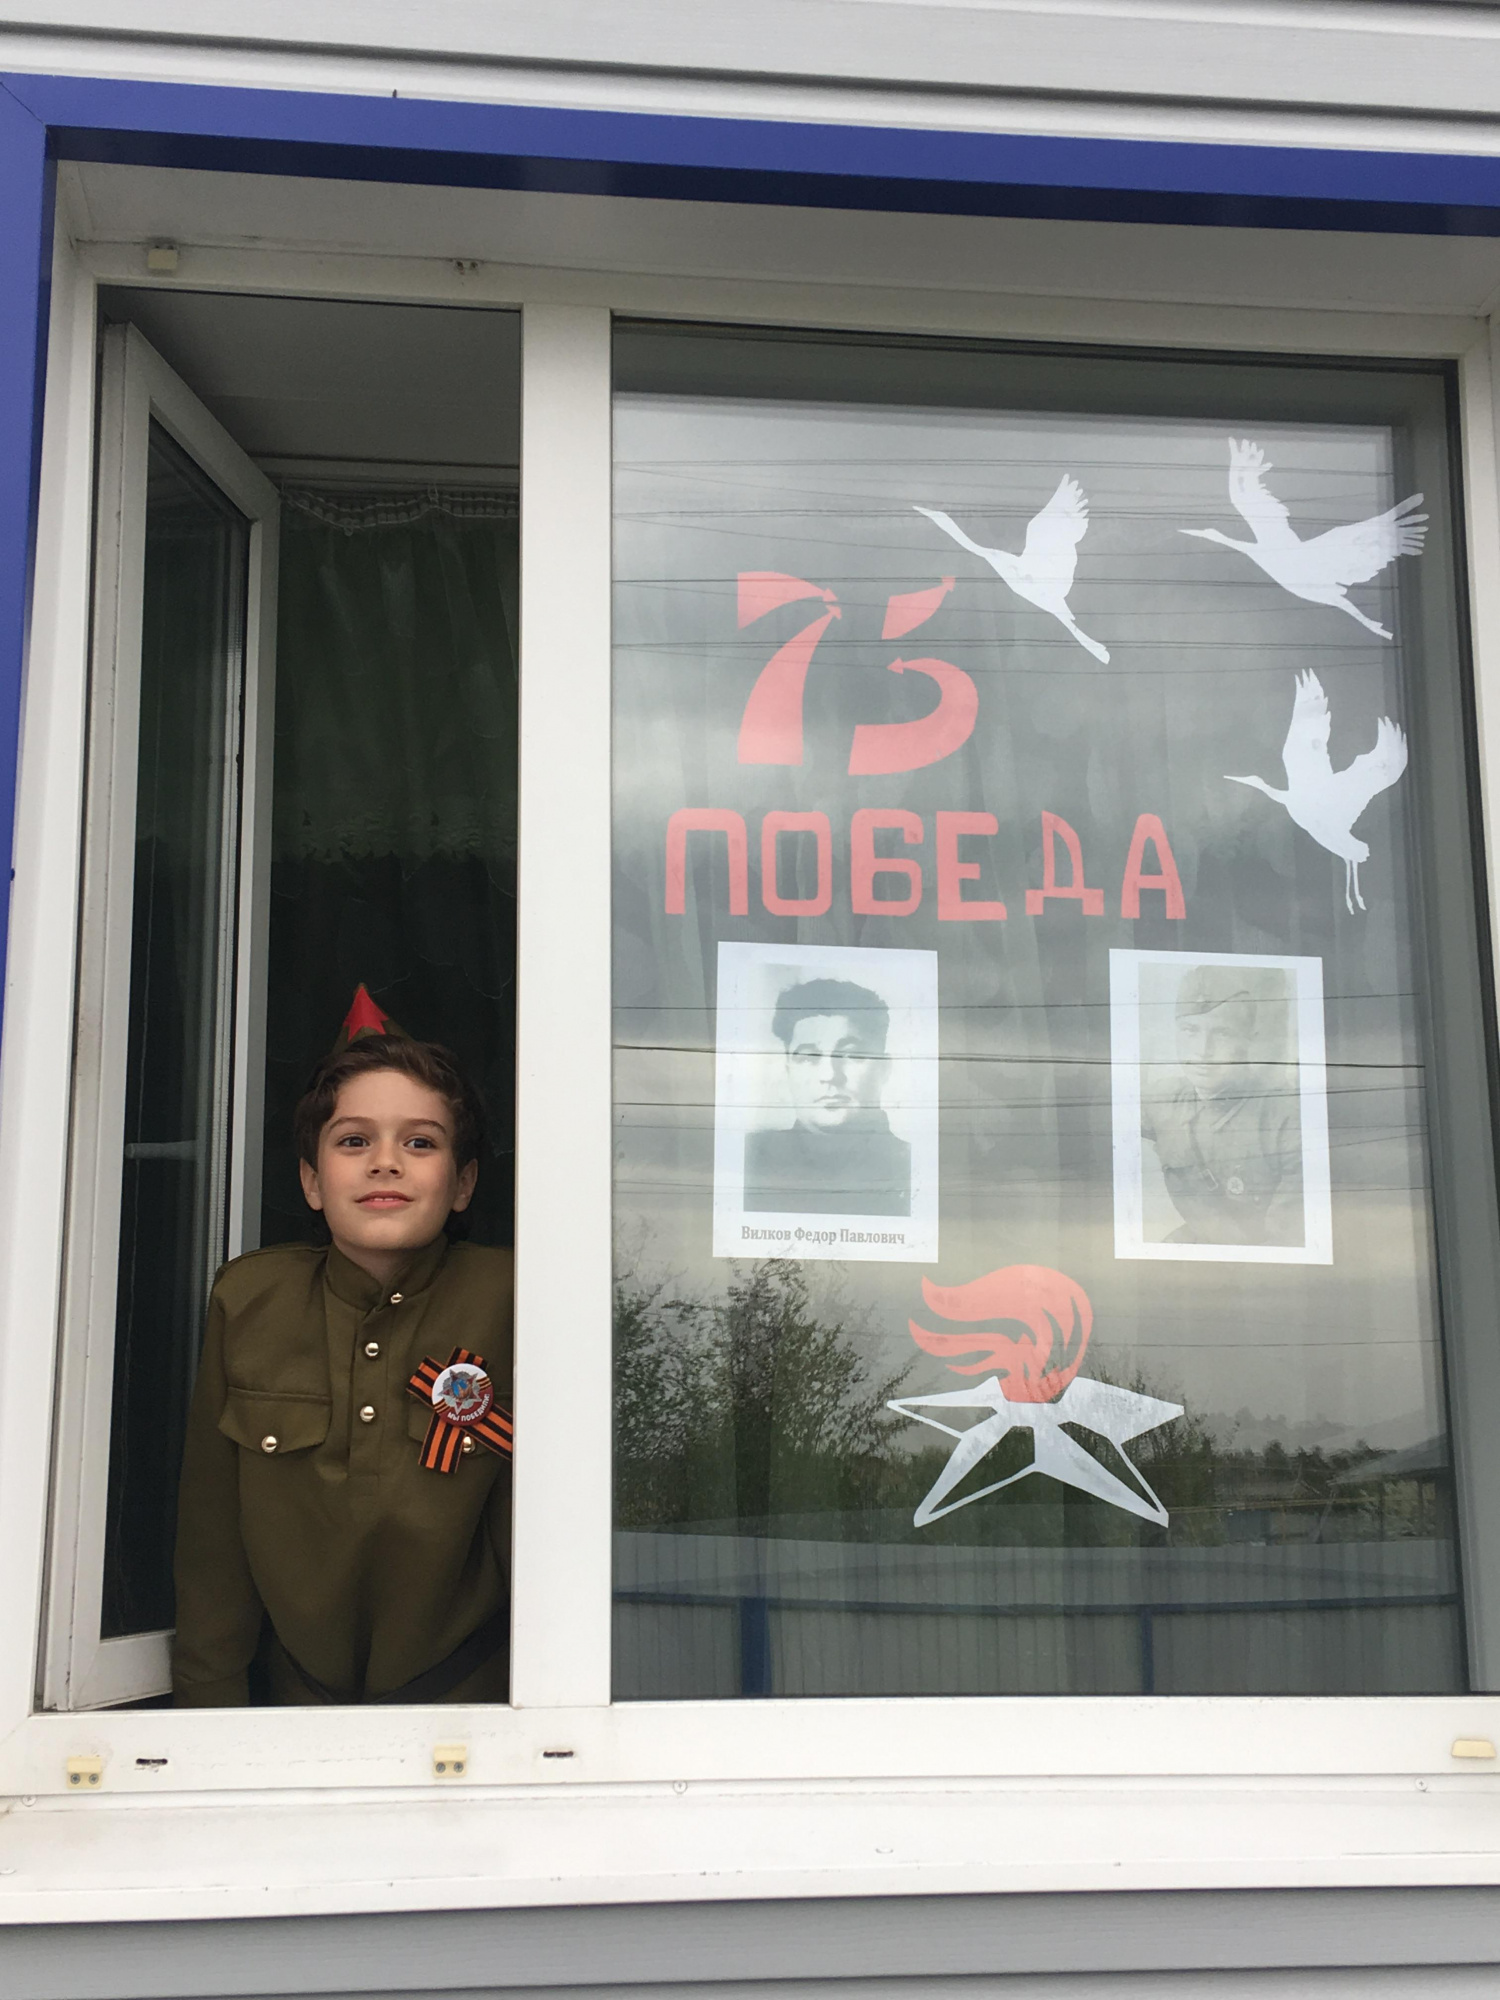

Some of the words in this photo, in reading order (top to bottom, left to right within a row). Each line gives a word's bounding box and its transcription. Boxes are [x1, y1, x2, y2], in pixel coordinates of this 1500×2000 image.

[737, 571, 979, 775] 75
[664, 808, 1187, 920] ПОБЕДА
[741, 1226, 791, 1241] Вилков
[794, 1227, 837, 1245] Федор
[840, 1229, 905, 1244] Павлович
[447, 1411, 460, 1422] МЫ
